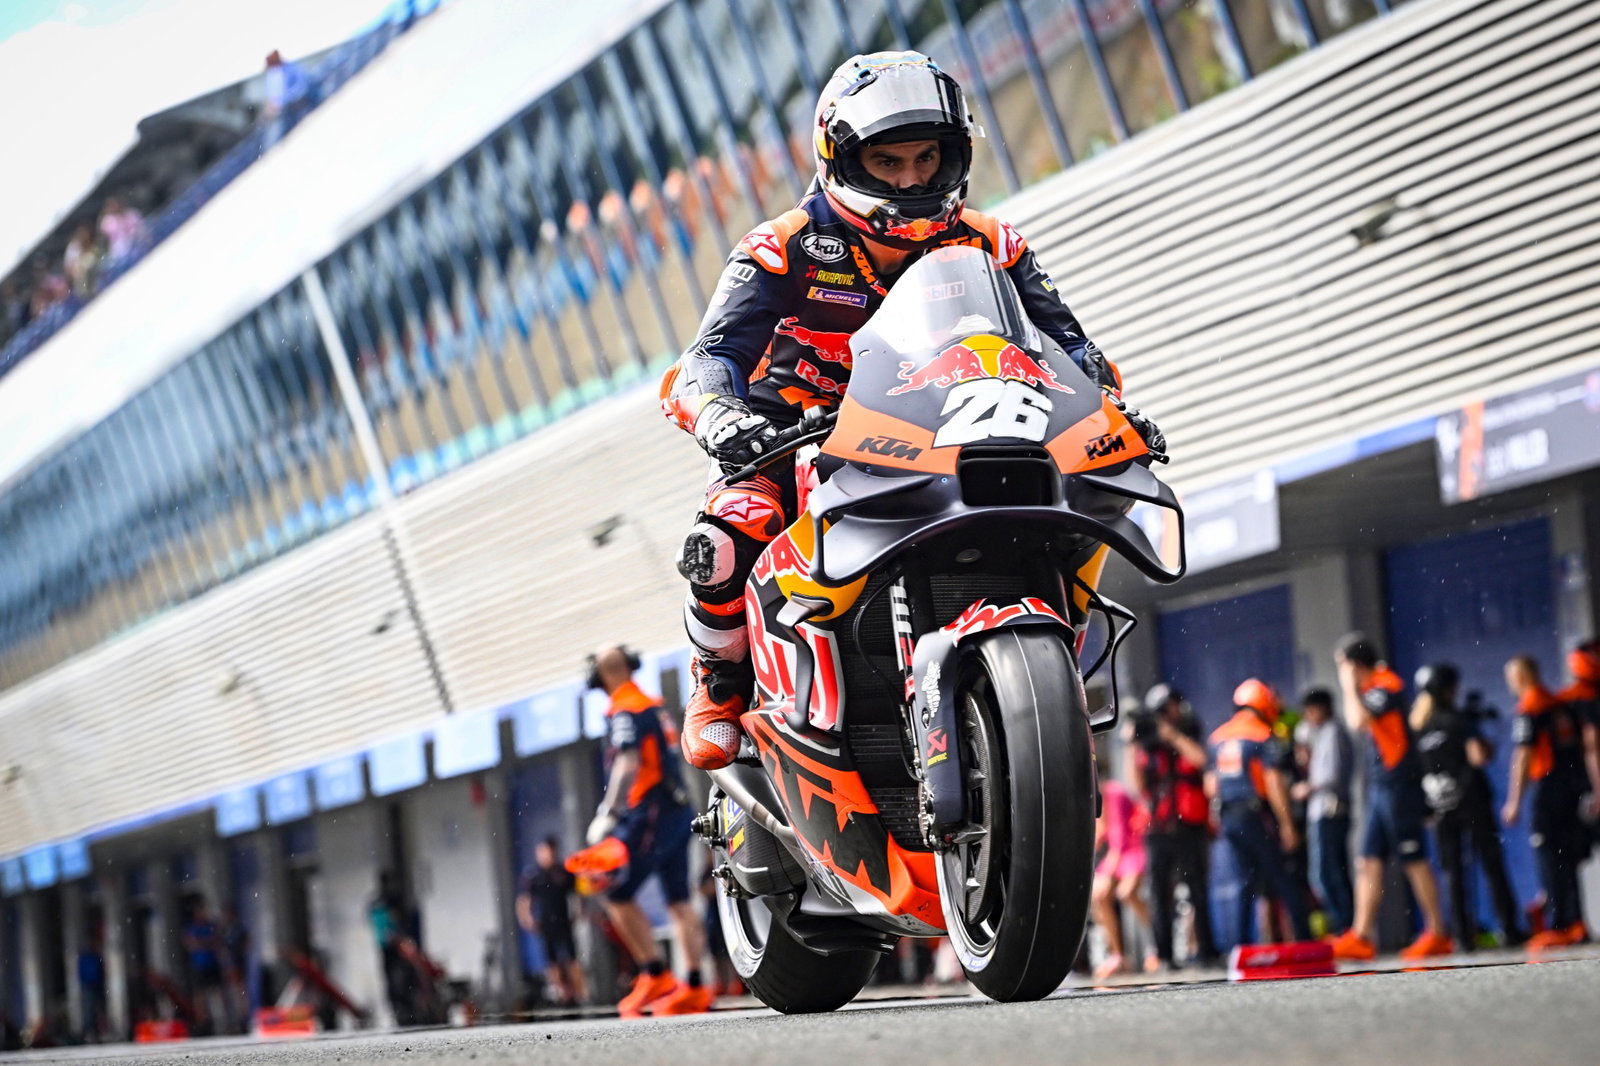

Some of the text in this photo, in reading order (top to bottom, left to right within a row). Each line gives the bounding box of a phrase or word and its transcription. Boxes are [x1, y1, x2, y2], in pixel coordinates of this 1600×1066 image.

[805, 237, 842, 255] Arai
[850, 245, 877, 284] KTM
[824, 293, 861, 303] MICHELIN
[931, 377, 1053, 449] 26
[856, 435, 924, 461] KTM
[1083, 433, 1126, 461] KTM
